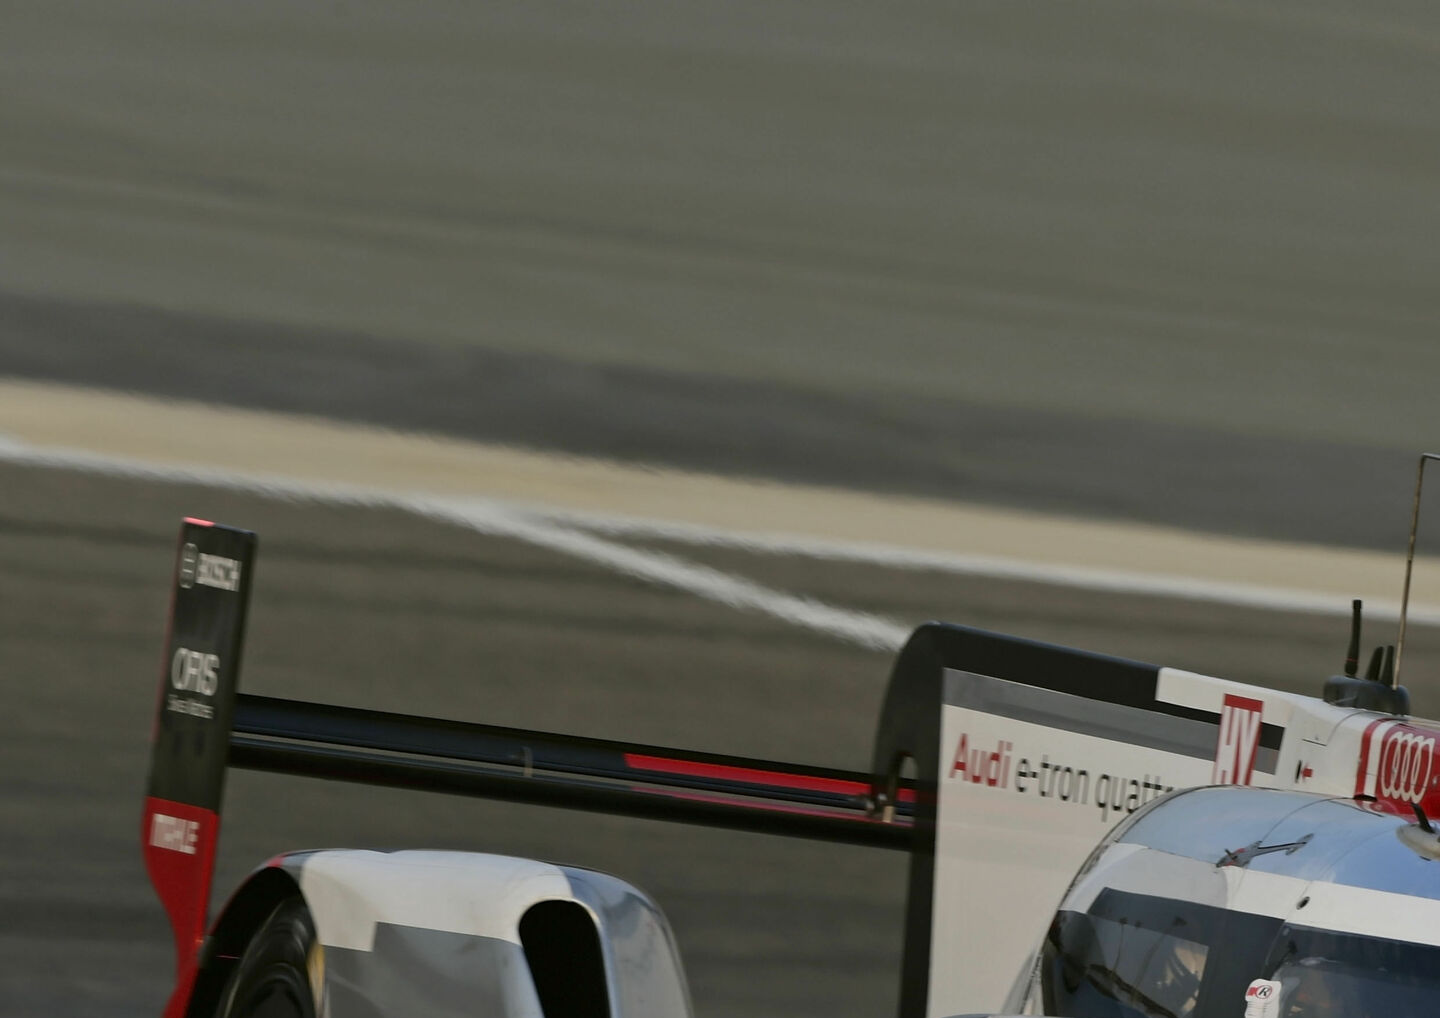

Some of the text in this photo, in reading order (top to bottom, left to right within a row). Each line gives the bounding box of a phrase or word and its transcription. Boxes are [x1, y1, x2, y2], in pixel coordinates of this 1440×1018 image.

[949, 733, 1013, 788] Audi
[1015, 754, 1089, 804] e-tron
[1213, 706, 1261, 785] HY
